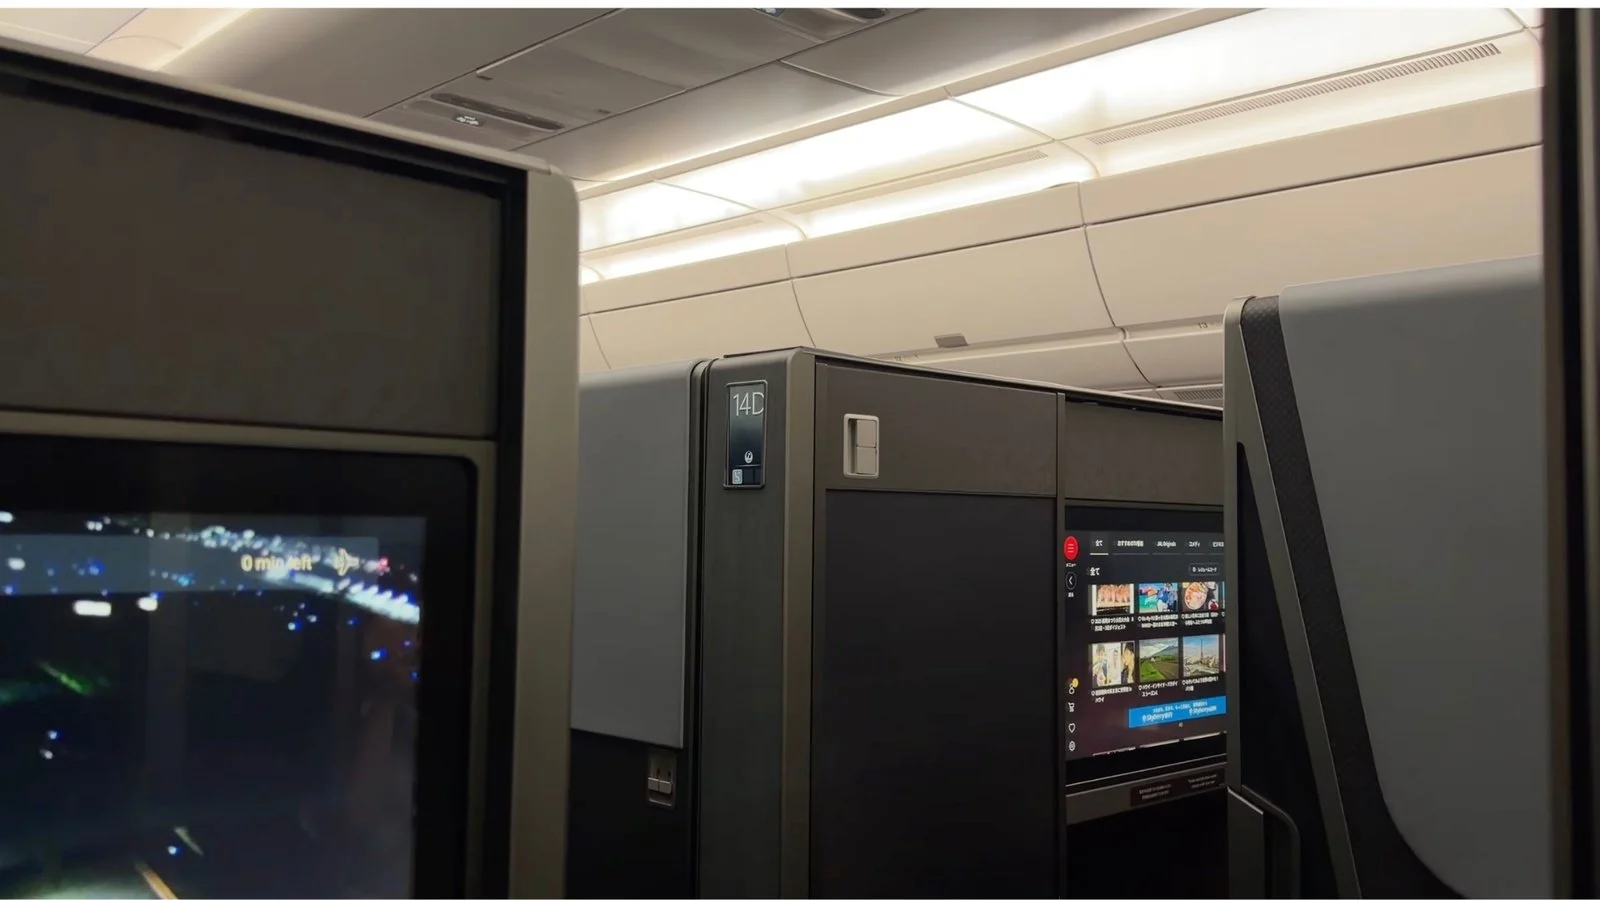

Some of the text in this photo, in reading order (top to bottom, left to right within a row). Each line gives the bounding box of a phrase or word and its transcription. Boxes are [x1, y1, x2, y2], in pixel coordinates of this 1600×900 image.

[732, 391, 765, 417] 14D
[240, 552, 313, 571] 0 min left
[1089, 566, 1100, 576] 全て
